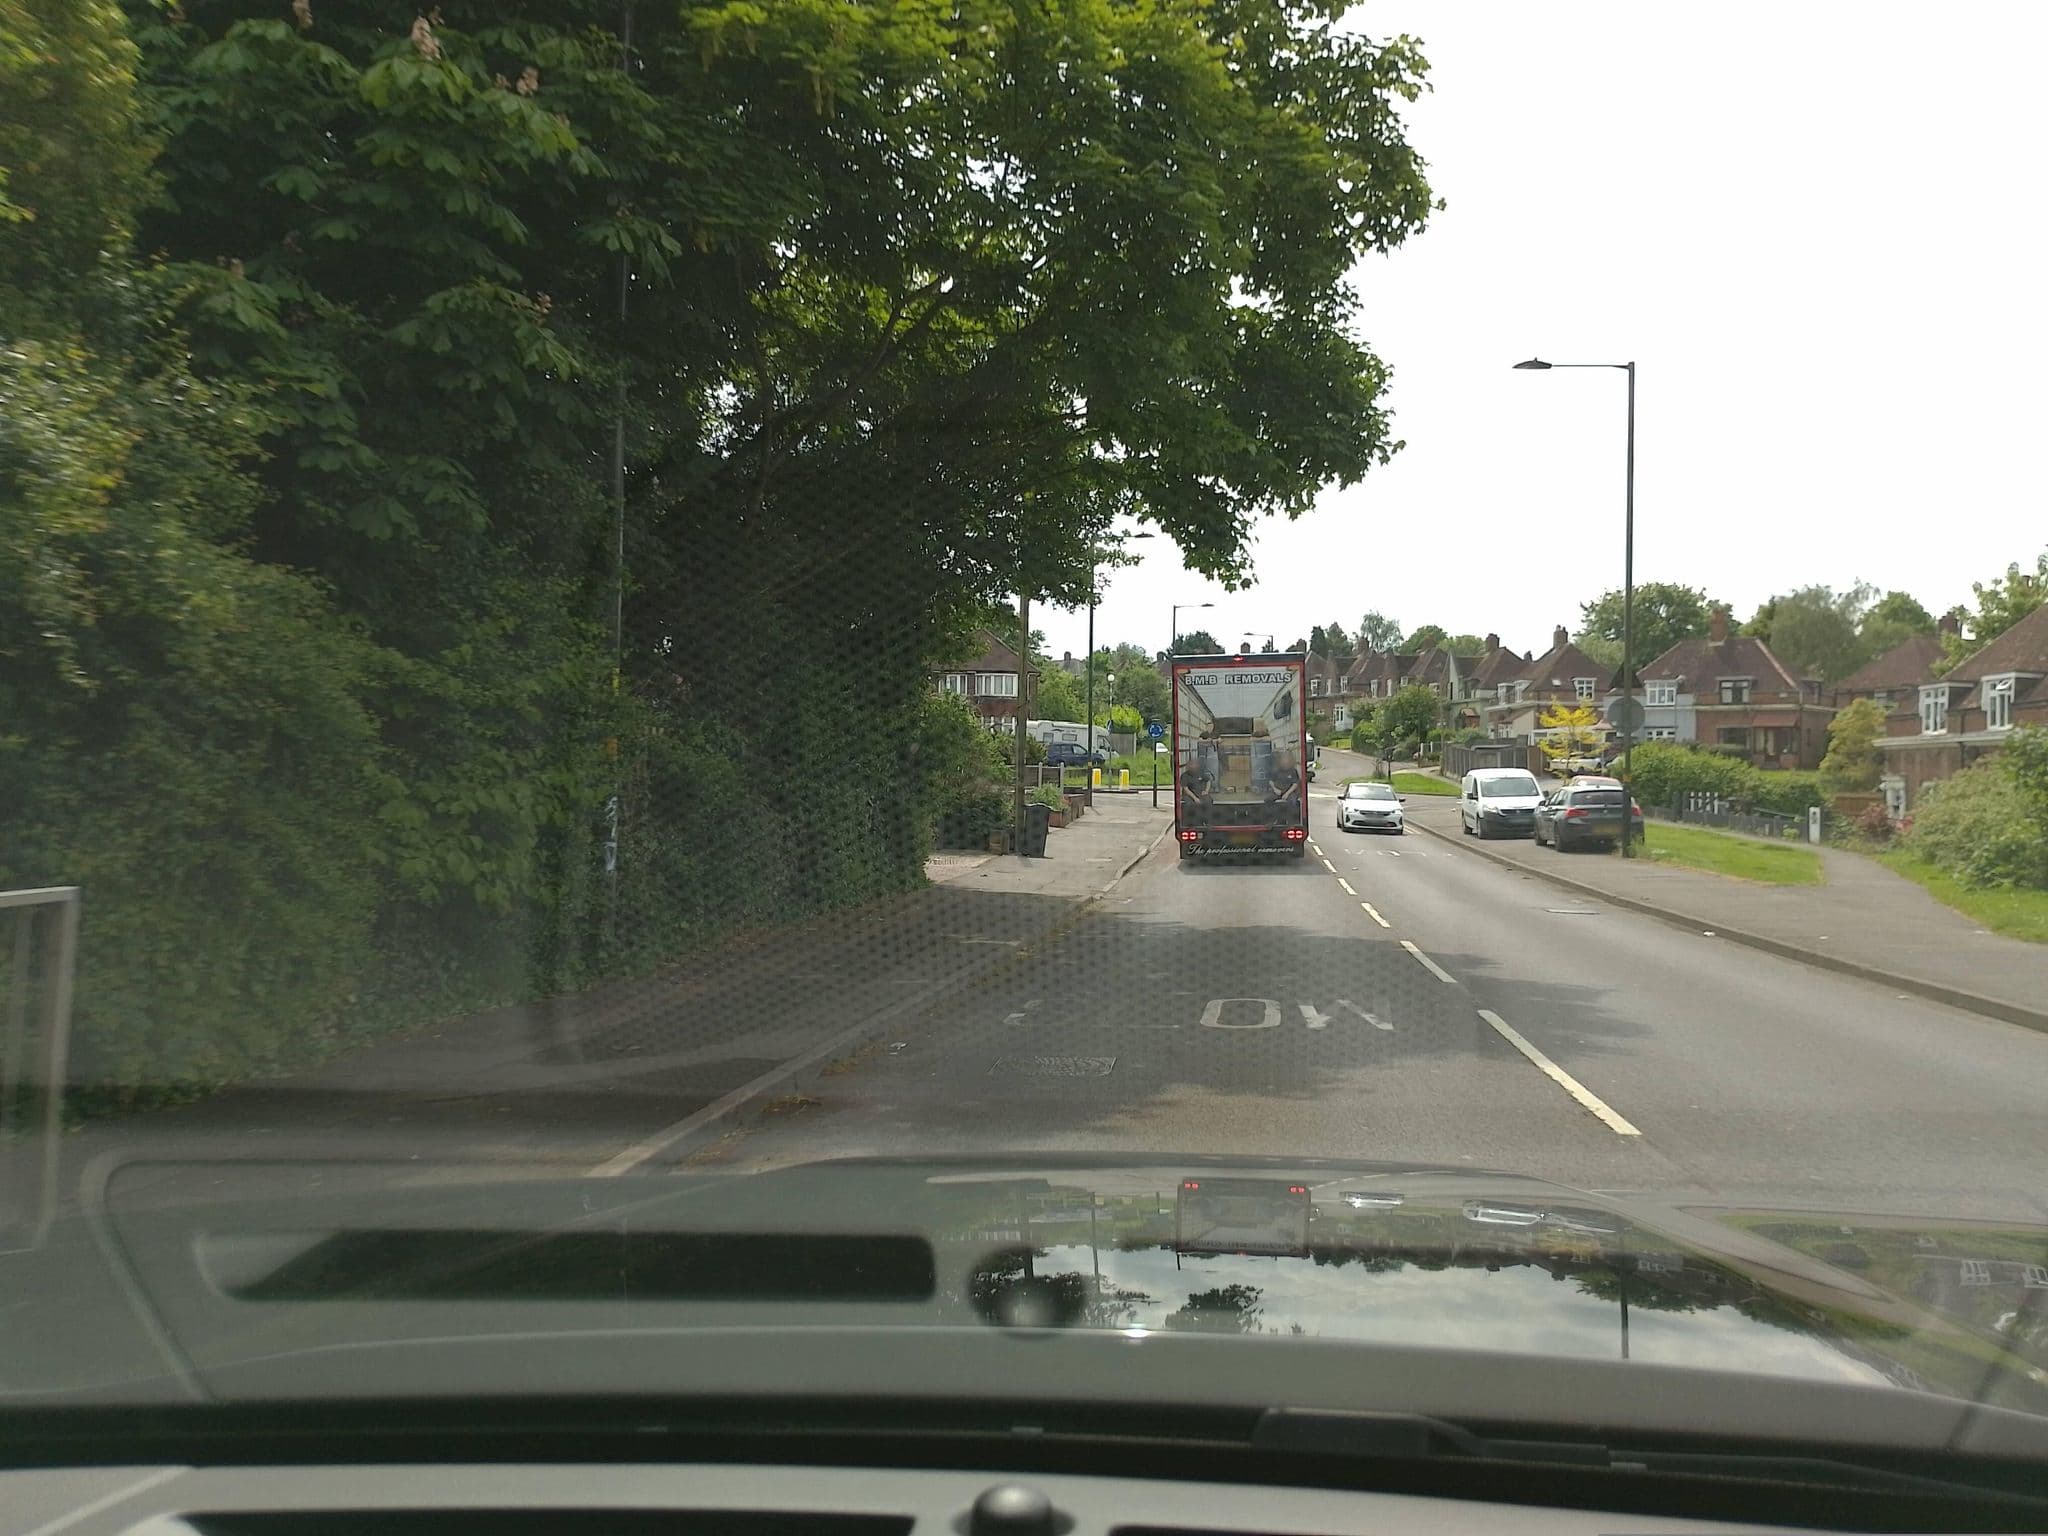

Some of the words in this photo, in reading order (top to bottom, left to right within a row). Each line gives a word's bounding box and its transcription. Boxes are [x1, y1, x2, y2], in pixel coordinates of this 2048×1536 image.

[1185, 674, 1218, 686] B.M.B
[1225, 672, 1293, 685] REMOVALS
[1187, 843, 1204, 855] The
[1204, 844, 1256, 856] professional
[1258, 845, 1295, 854] removers
